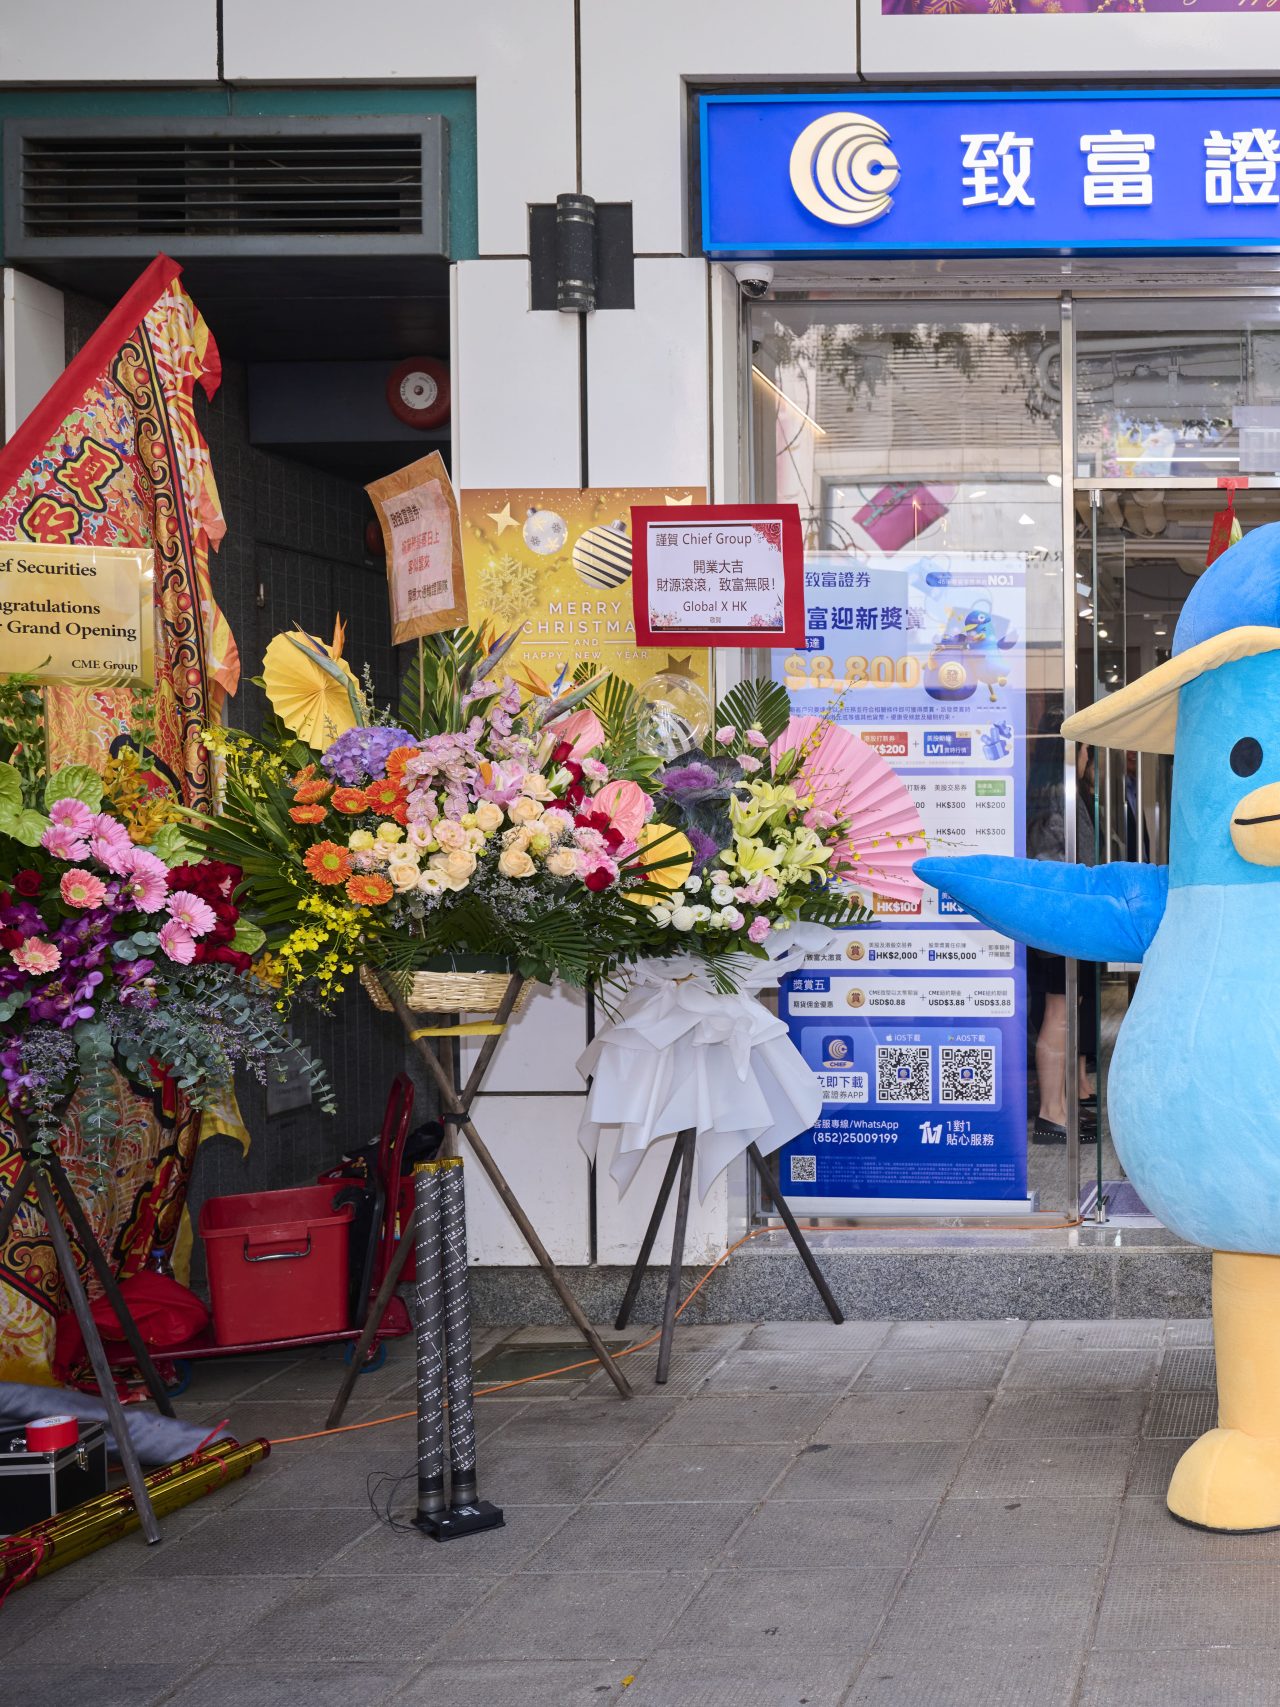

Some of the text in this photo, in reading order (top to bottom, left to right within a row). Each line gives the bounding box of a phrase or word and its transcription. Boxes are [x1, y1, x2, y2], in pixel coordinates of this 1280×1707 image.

[656, 533, 752, 547] 謹賀 Chief Group
[17, 558, 97, 576] Securities
[693, 560, 743, 574] 開業大吉
[805, 572, 871, 587] 致富證券
[988, 575, 1014, 586] NO.1
[0, 599, 100, 615] gratulations
[549, 602, 621, 615] MERRY
[683, 601, 747, 612] Global X HK
[7, 620, 61, 635] Grand
[66, 622, 137, 641] Opening
[522, 620, 636, 634] CHRISTMA
[574, 638, 599, 647] AND
[523, 652, 563, 660] HAPPY
[617, 651, 648, 659] YEAR
[71, 660, 138, 672] CME Group
[784, 653, 921, 694] $8,800
[927, 744, 943, 754] LV1
[936, 801, 966, 809] HK$300
[936, 828, 1005, 836] HK$400 HK$300
[877, 902, 917, 912] HK$100
[876, 951, 918, 961] HK$2,000
[936, 952, 977, 961] HK$5,000
[793, 979, 826, 991] 獎賞五
[947, 1120, 971, 1132] 1對1
[813, 1132, 898, 1144] (852)25009199
[946, 1134, 994, 1146] 貼心服務
